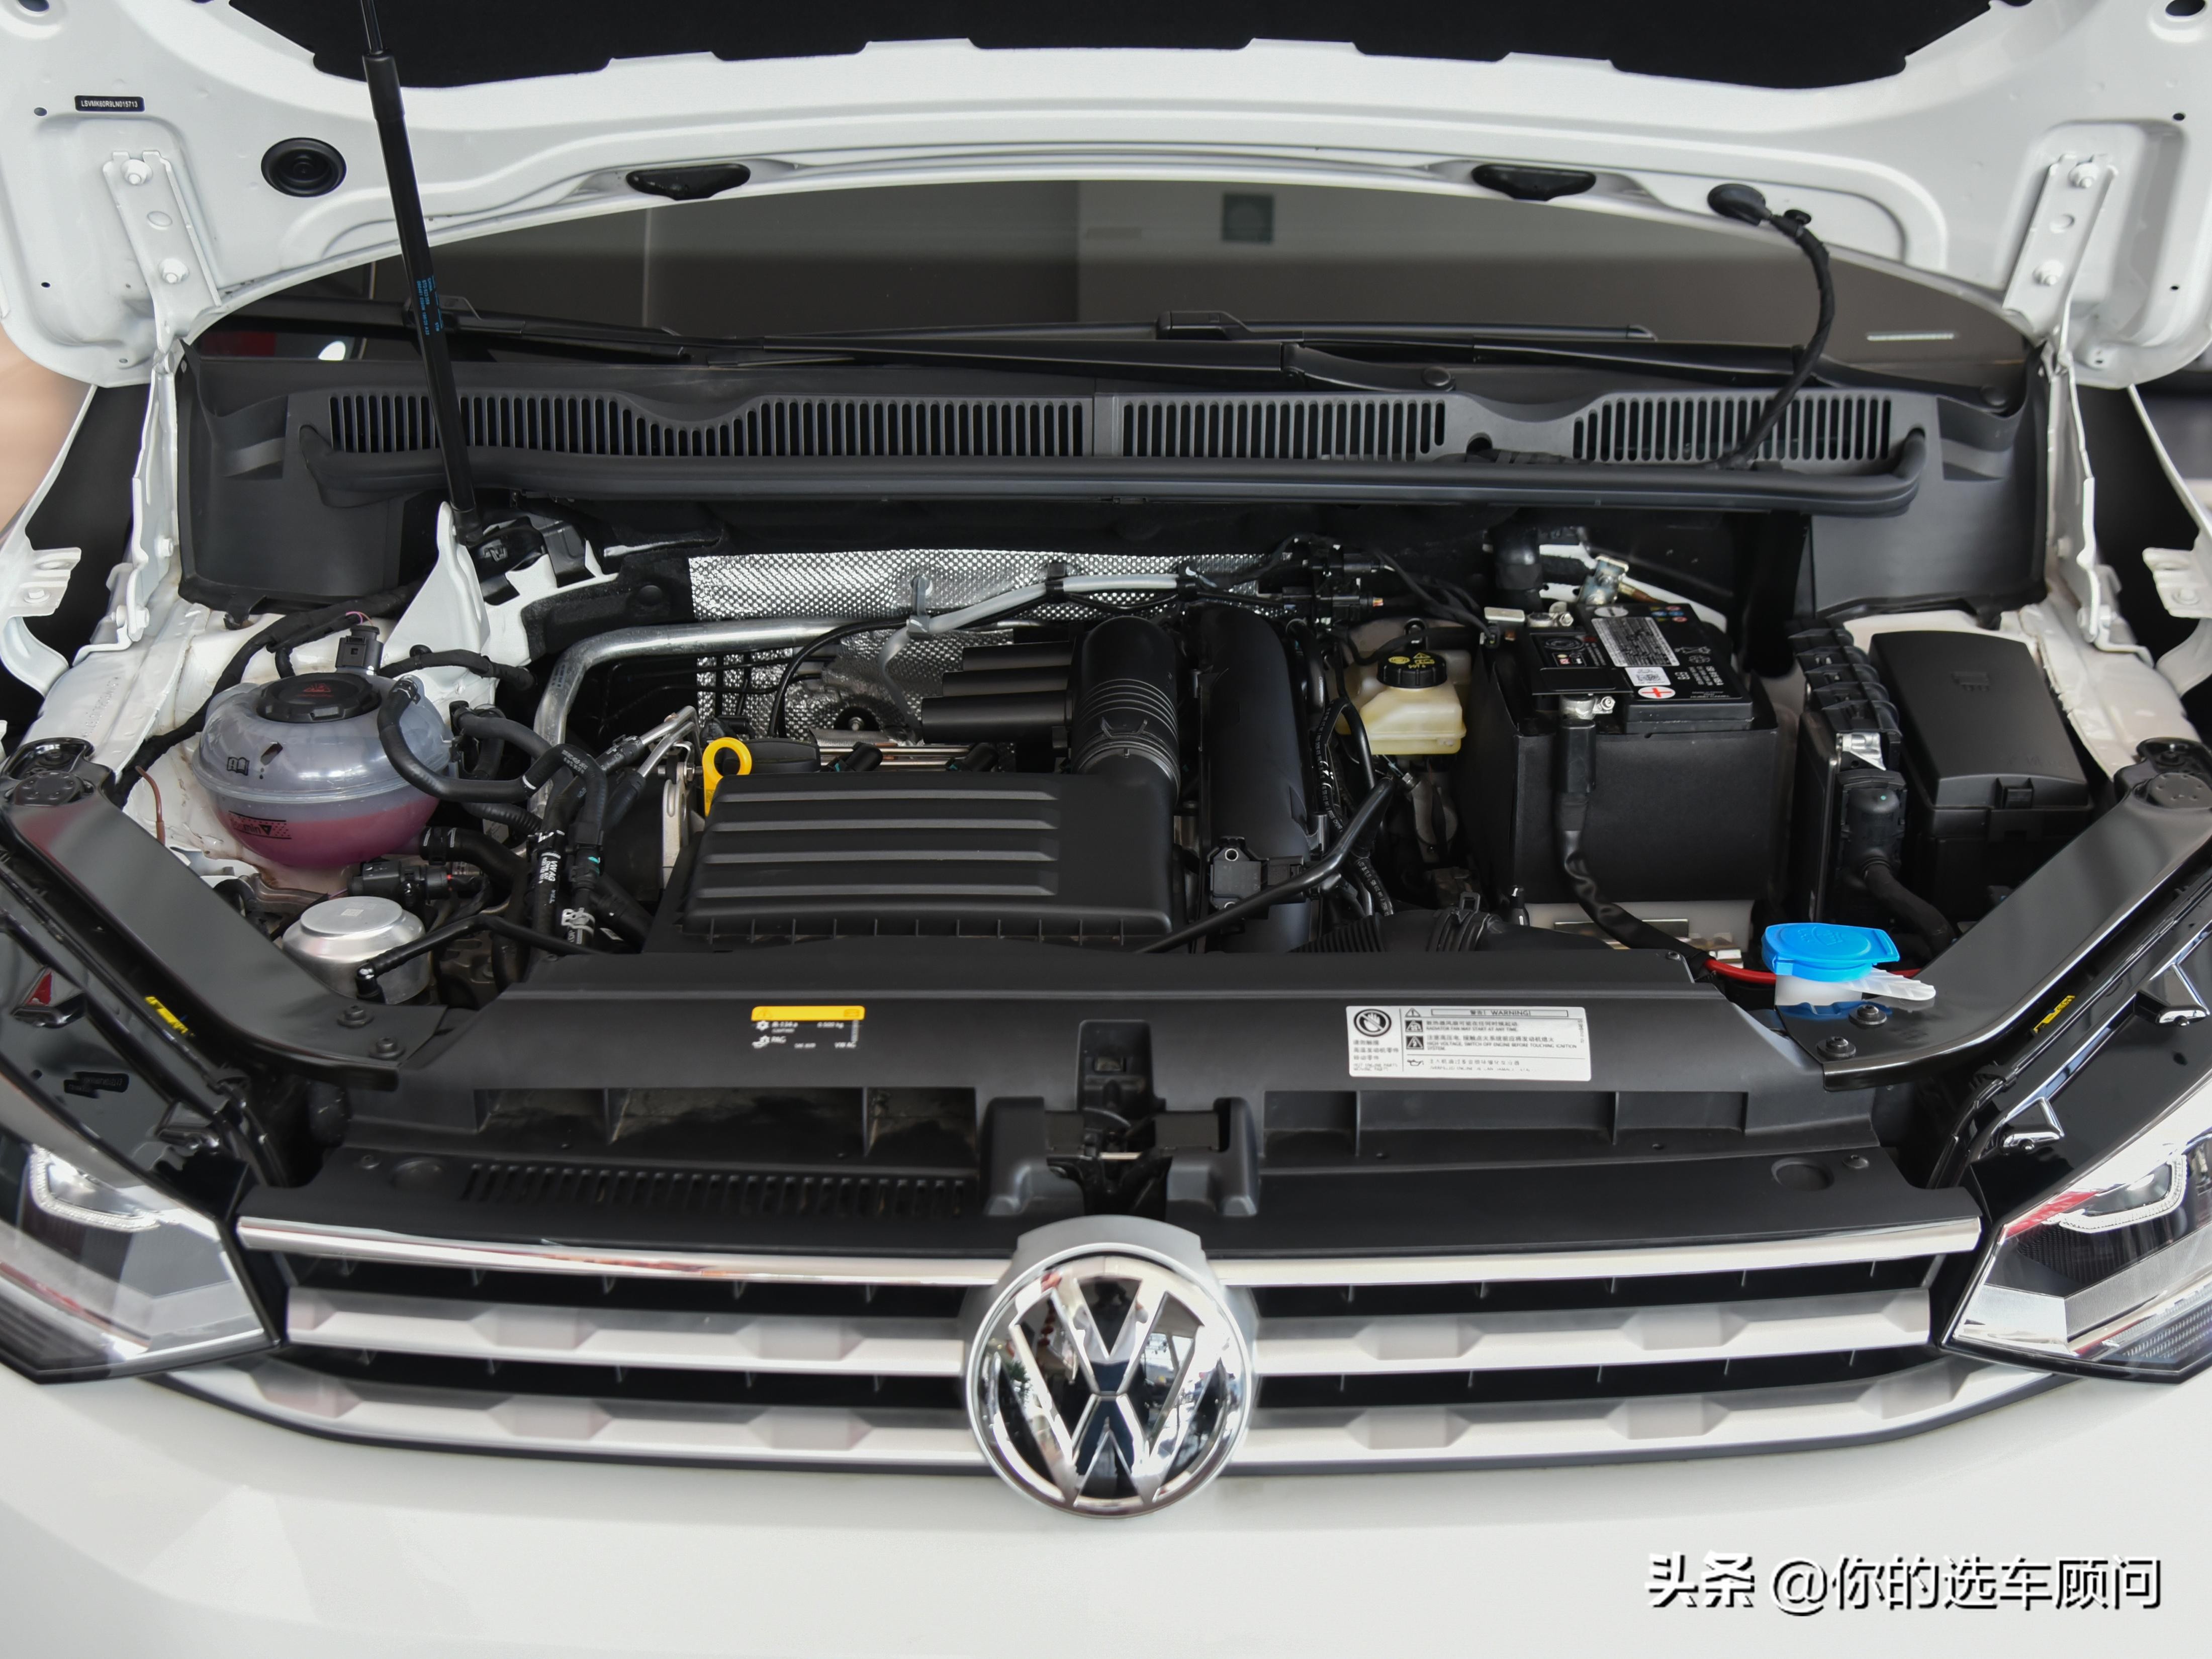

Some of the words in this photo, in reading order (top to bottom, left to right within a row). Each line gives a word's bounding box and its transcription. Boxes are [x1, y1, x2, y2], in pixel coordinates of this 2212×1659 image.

[243, 823, 261, 834] min
[550, 861, 558, 872] VW
[548, 871, 556, 881] AG
[995, 1254, 1223, 1508] VW
